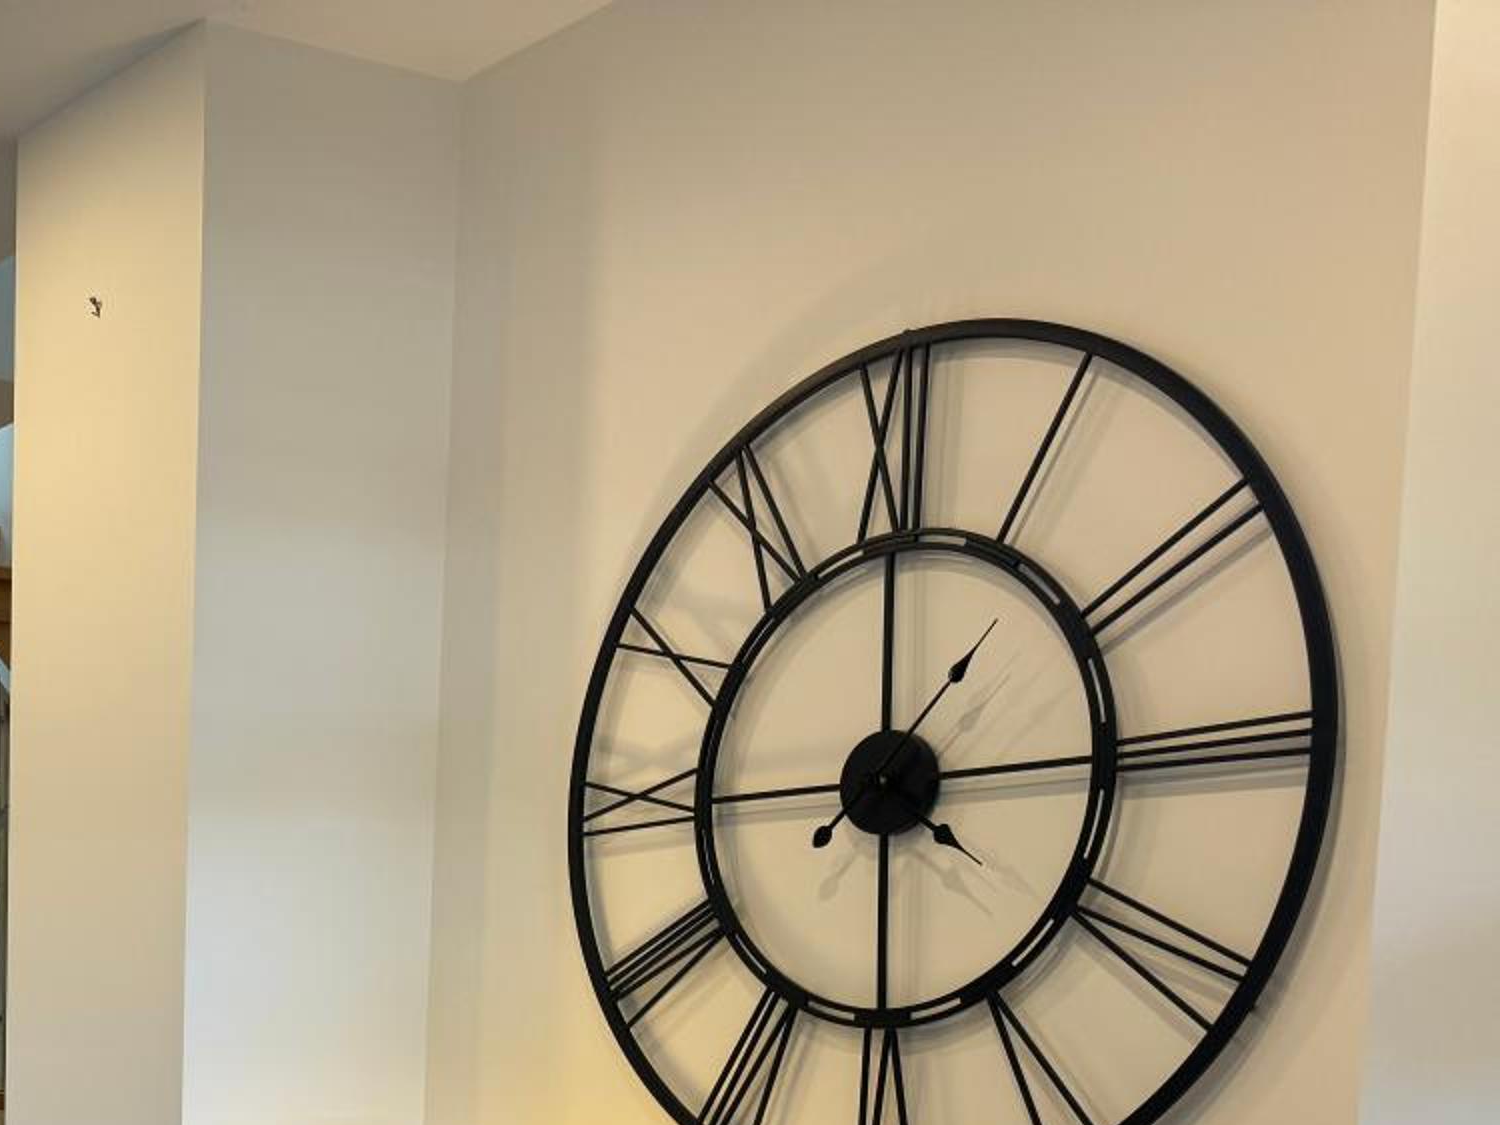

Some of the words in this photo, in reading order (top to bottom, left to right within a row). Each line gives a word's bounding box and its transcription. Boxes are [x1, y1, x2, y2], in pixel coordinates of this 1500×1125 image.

[1079, 477, 1266, 638] II
[616, 606, 731, 708] X
[1115, 709, 1316, 772] III
